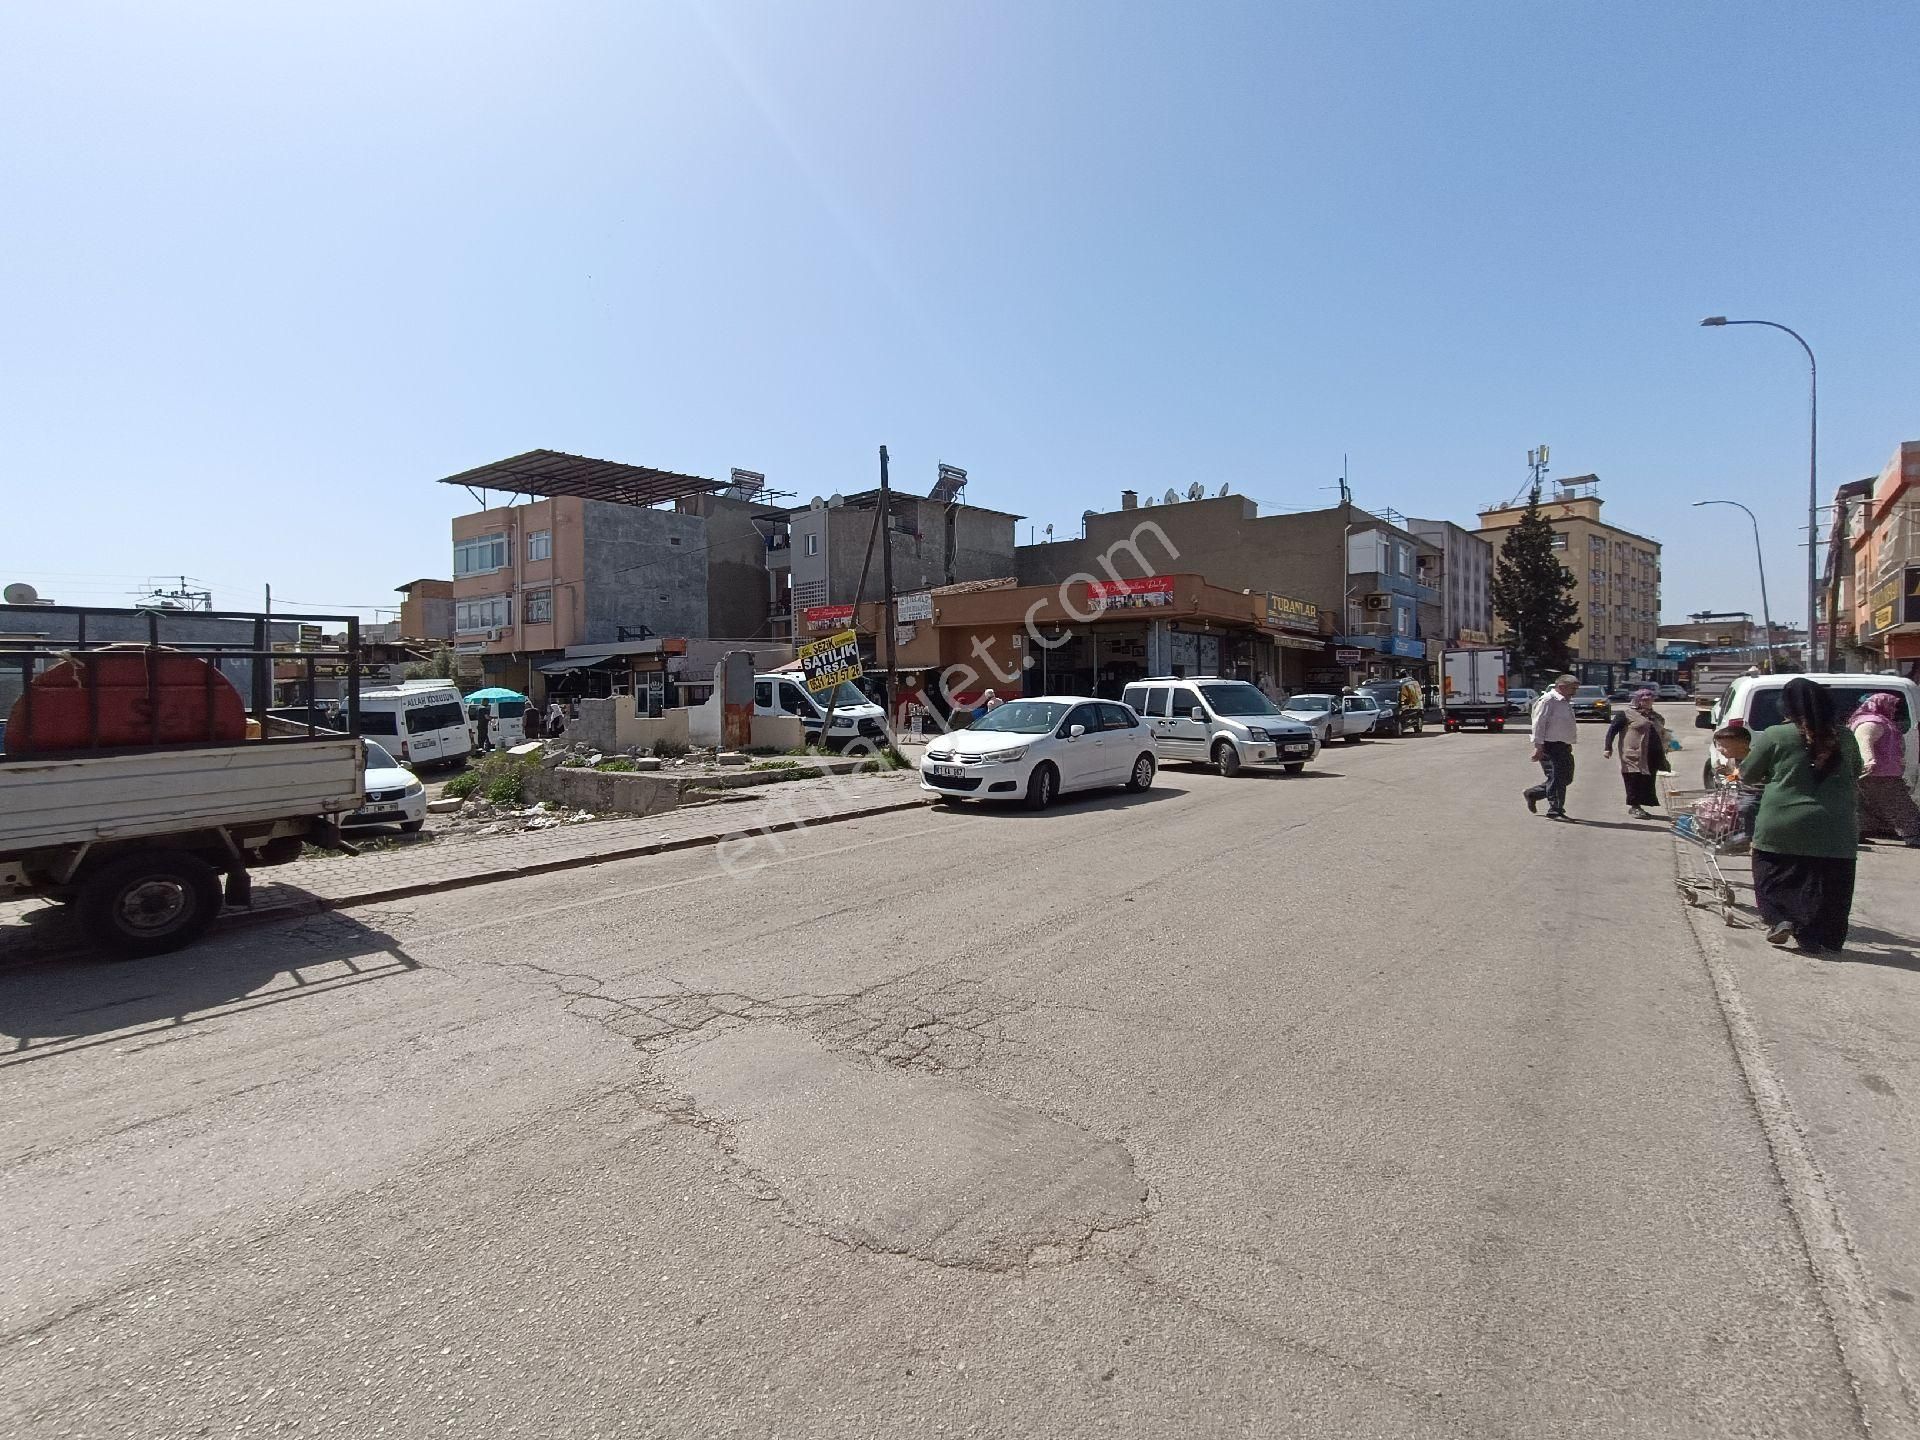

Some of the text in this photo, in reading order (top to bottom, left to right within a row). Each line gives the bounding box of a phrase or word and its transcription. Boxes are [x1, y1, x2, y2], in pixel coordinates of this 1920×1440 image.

[1271, 595, 1316, 618] TURANLAR
[803, 643, 857, 670] SATILIK
[815, 659, 849, 677] ARSA
[407, 696, 427, 707] ALLAH
